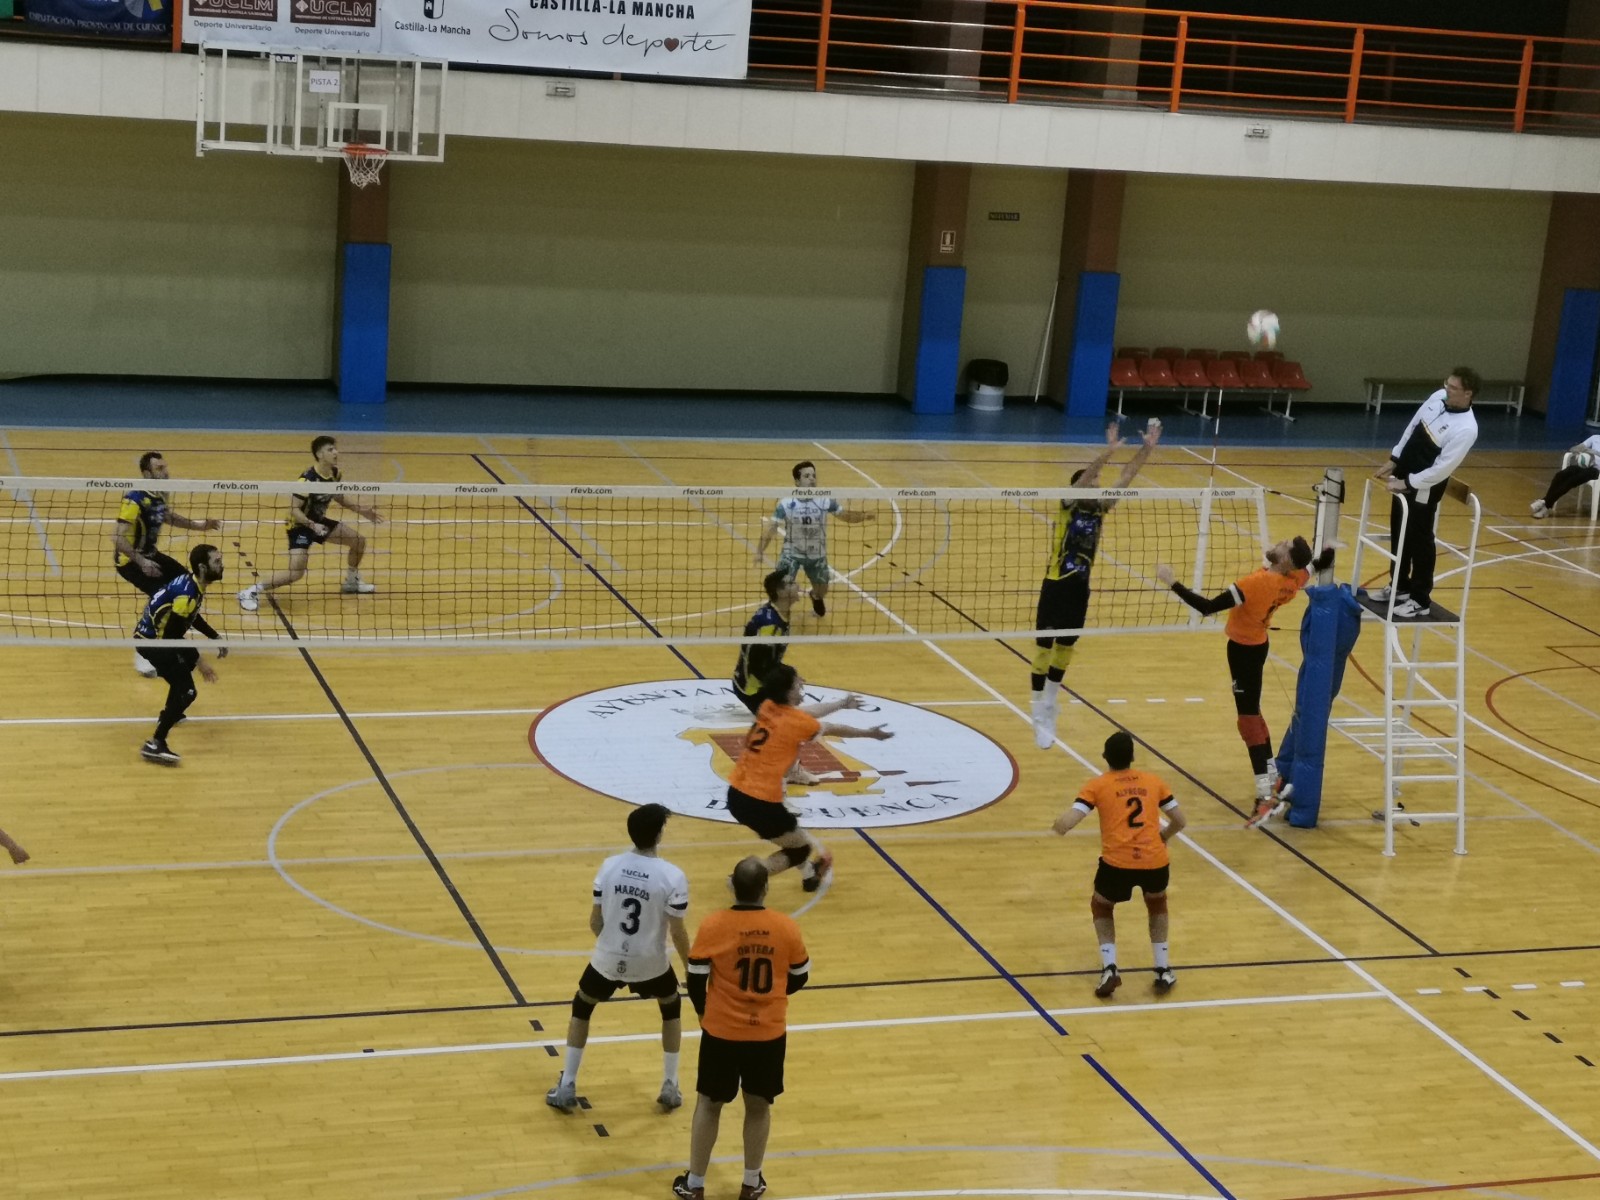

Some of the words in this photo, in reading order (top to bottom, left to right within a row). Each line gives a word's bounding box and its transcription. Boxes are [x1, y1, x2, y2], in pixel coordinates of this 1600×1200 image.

[310, 0, 372, 17] UCLM
[632, 3, 695, 19] MANCHA
[194, 20, 223, 29] Deporte
[225, 22, 272, 31] Universitario
[394, 20, 438, 33] Castilla-La
[440, 24, 471, 36] Mancha
[488, 8, 589, 45] Somos
[295, 26, 322, 35] Deporte
[325, 28, 370, 37] Universitario
[85, 479, 134, 489] rfevb.com
[212, 481, 259, 491] rfevb.com
[335, 483, 380, 492] rfevb.com
[455, 485, 498, 493] rfevb.com
[570, 487, 613, 495] rfevb.com
[682, 488, 724, 496] rfevb.com
[1125, 796, 1144, 828] 2
[626, 869, 650, 880] UCLM
[614, 884, 650, 901] MARCOS
[619, 898, 642, 936] 3
[735, 957, 773, 994] 10
